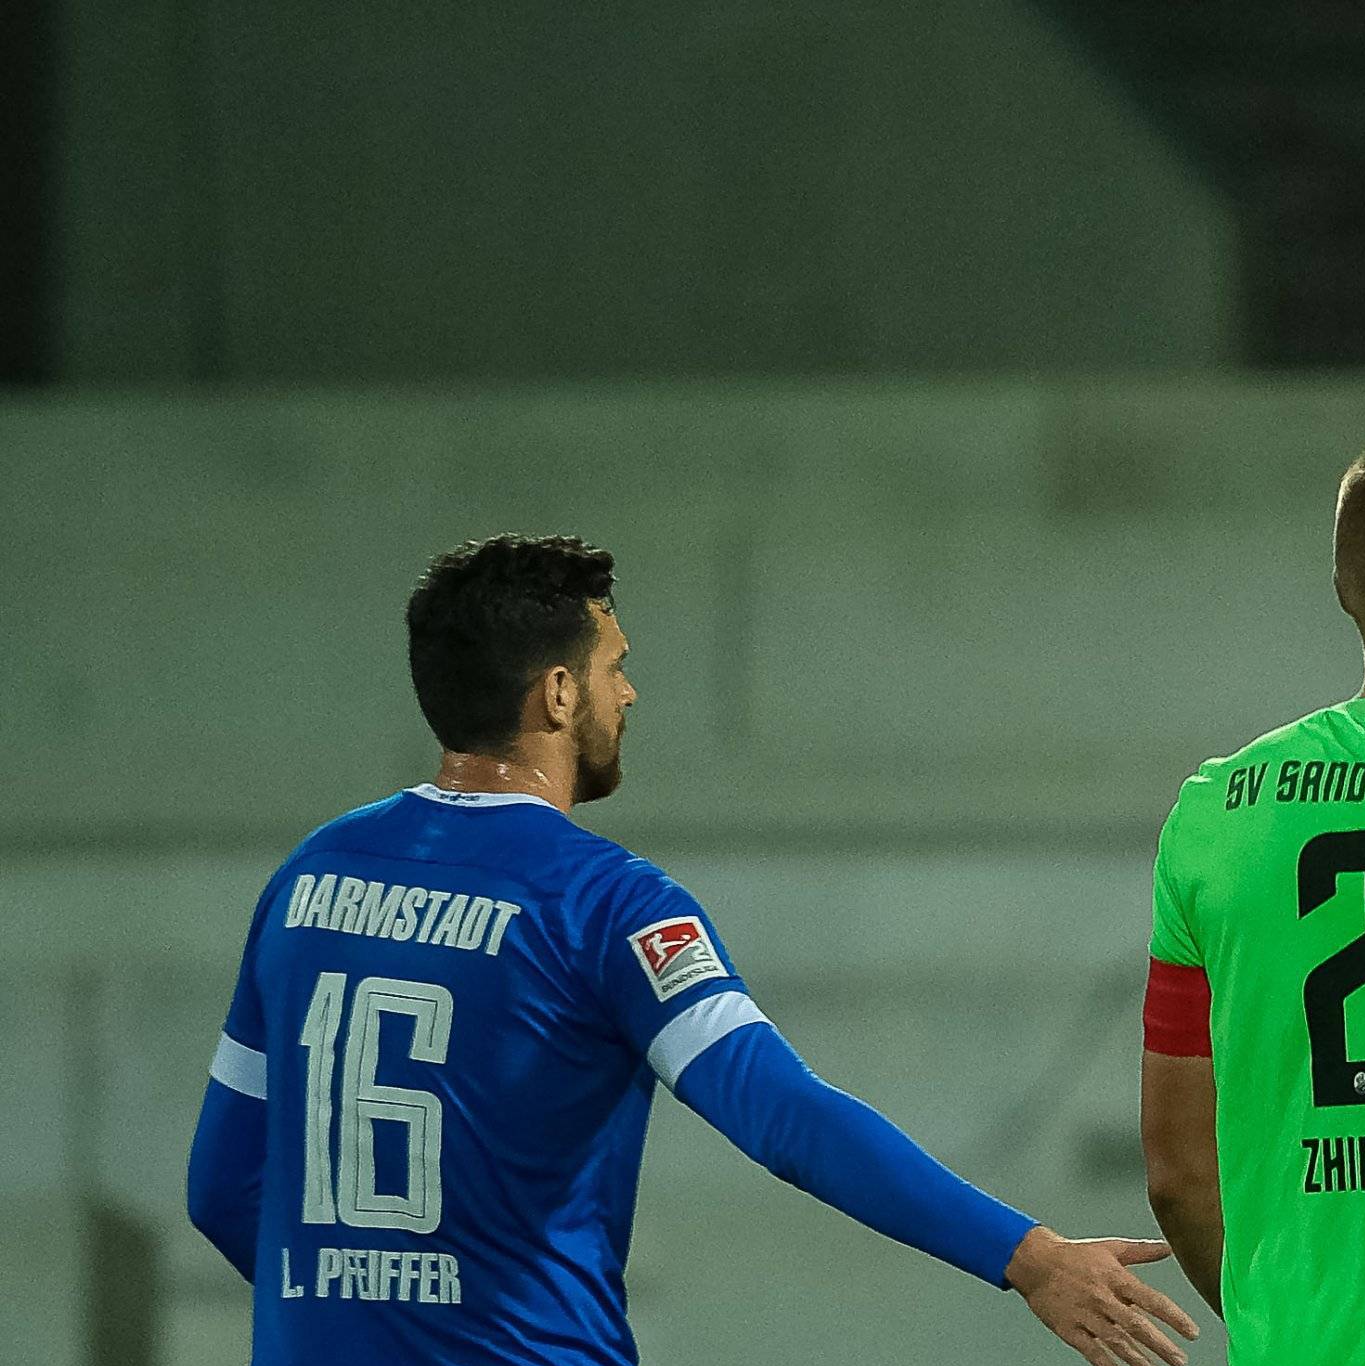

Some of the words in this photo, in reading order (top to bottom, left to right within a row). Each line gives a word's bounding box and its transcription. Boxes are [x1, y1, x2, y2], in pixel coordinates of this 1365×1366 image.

[1226, 767, 1264, 811] SV
[284, 873, 522, 956] DARMSTADT
[300, 971, 454, 1235] 16
